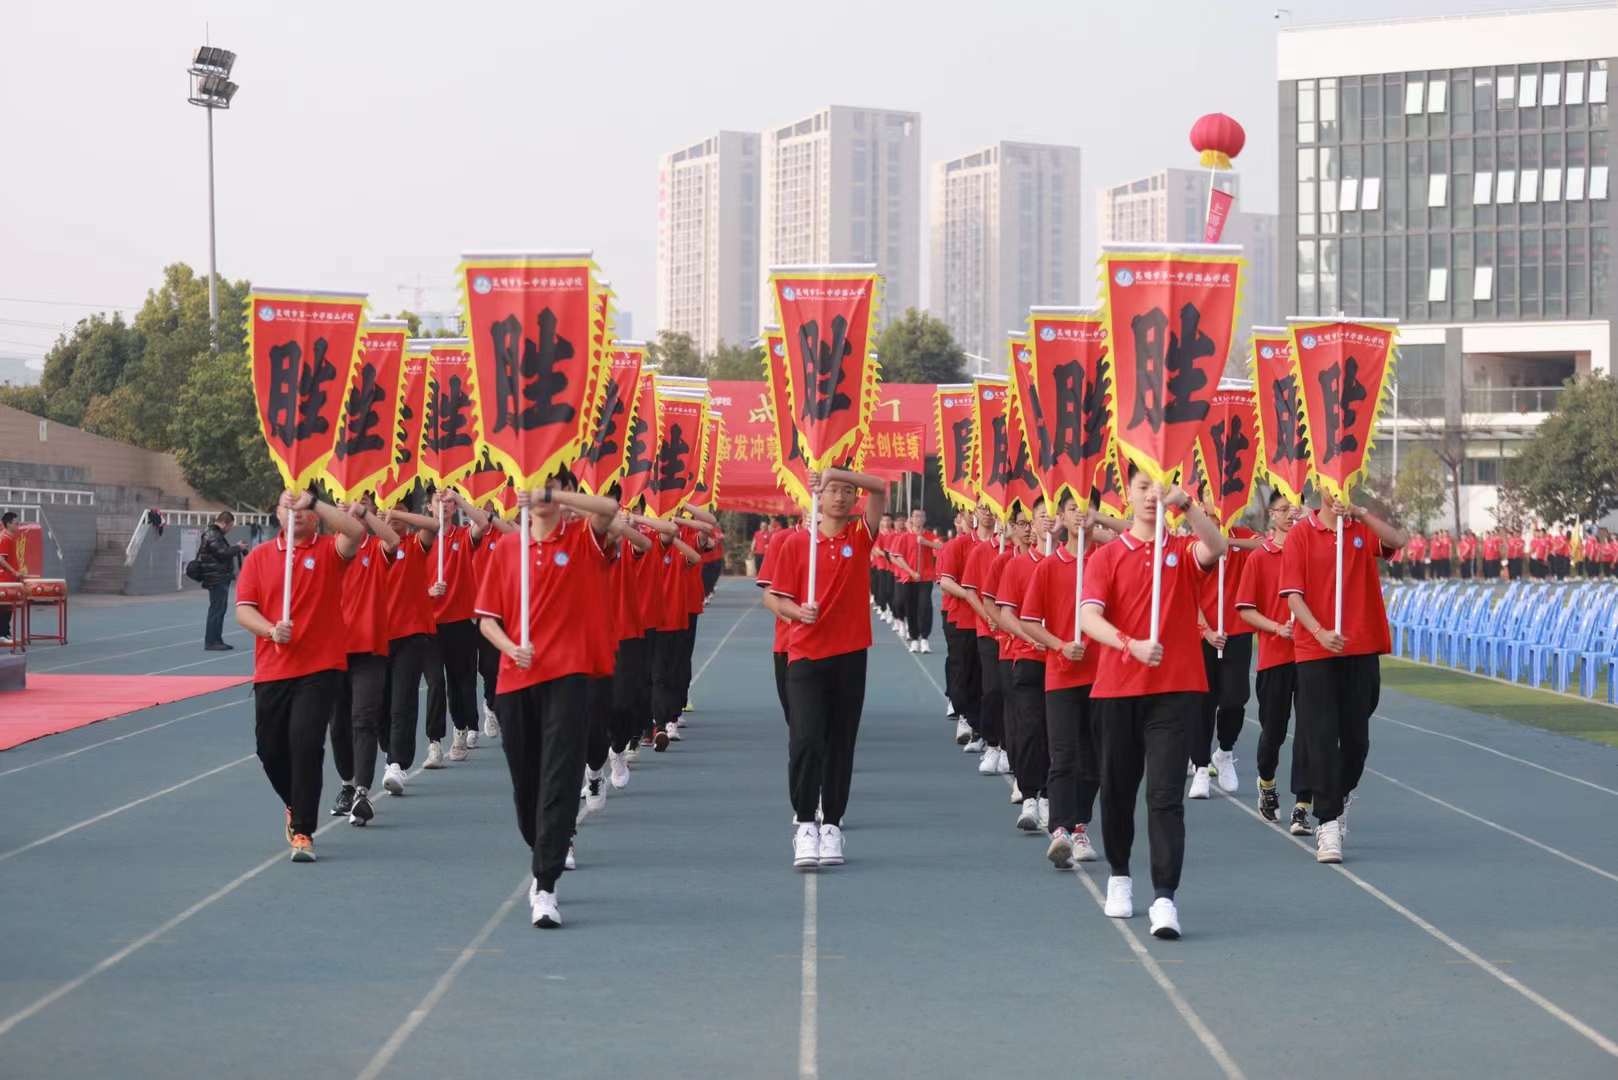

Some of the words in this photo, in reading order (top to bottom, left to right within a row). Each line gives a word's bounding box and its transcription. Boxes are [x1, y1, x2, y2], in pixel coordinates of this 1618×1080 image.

[268, 337, 336, 448] 胜
[491, 306, 576, 440] 胜
[1127, 302, 1215, 434] 胜
